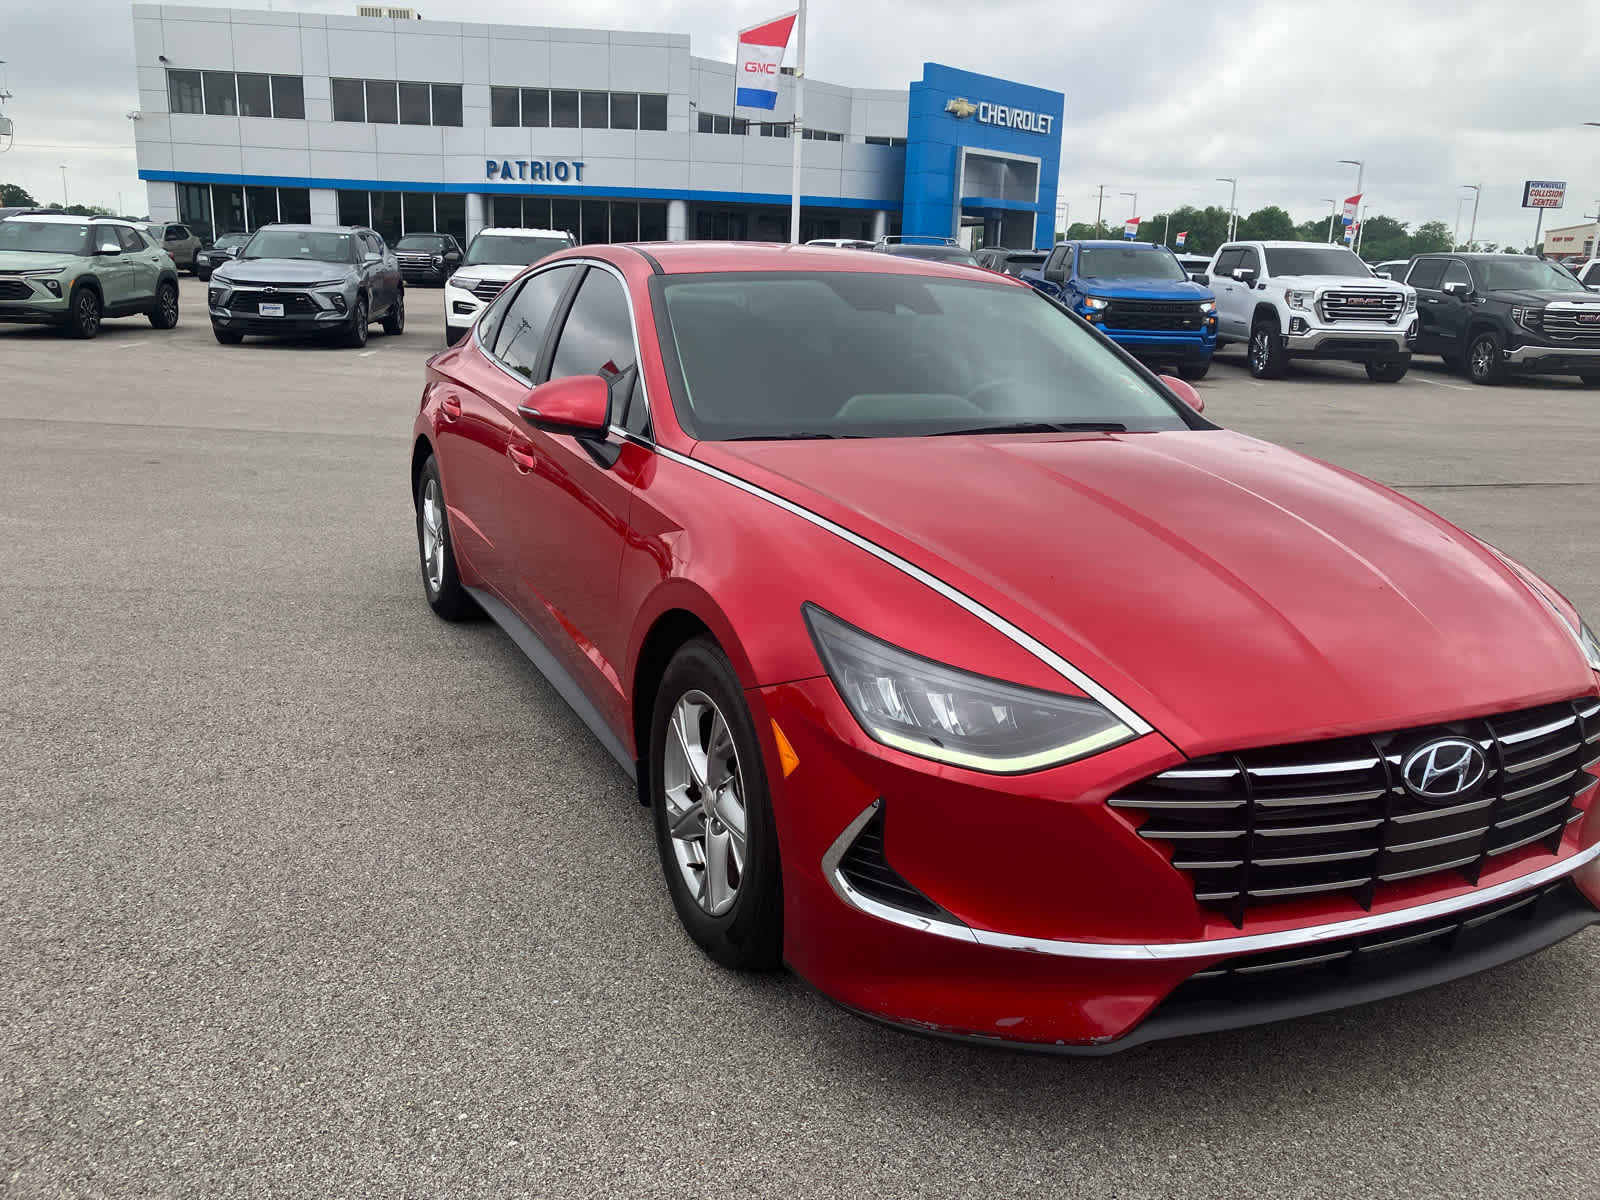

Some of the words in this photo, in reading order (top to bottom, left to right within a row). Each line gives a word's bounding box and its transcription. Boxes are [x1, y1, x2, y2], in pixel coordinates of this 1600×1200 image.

[744, 61, 777, 74] GMC
[979, 101, 1054, 134] CHEVROLET
[486, 159, 585, 182] PATRIOT
[1530, 189, 1564, 198] COLLISION
[1532, 198, 1558, 206] CENTER
